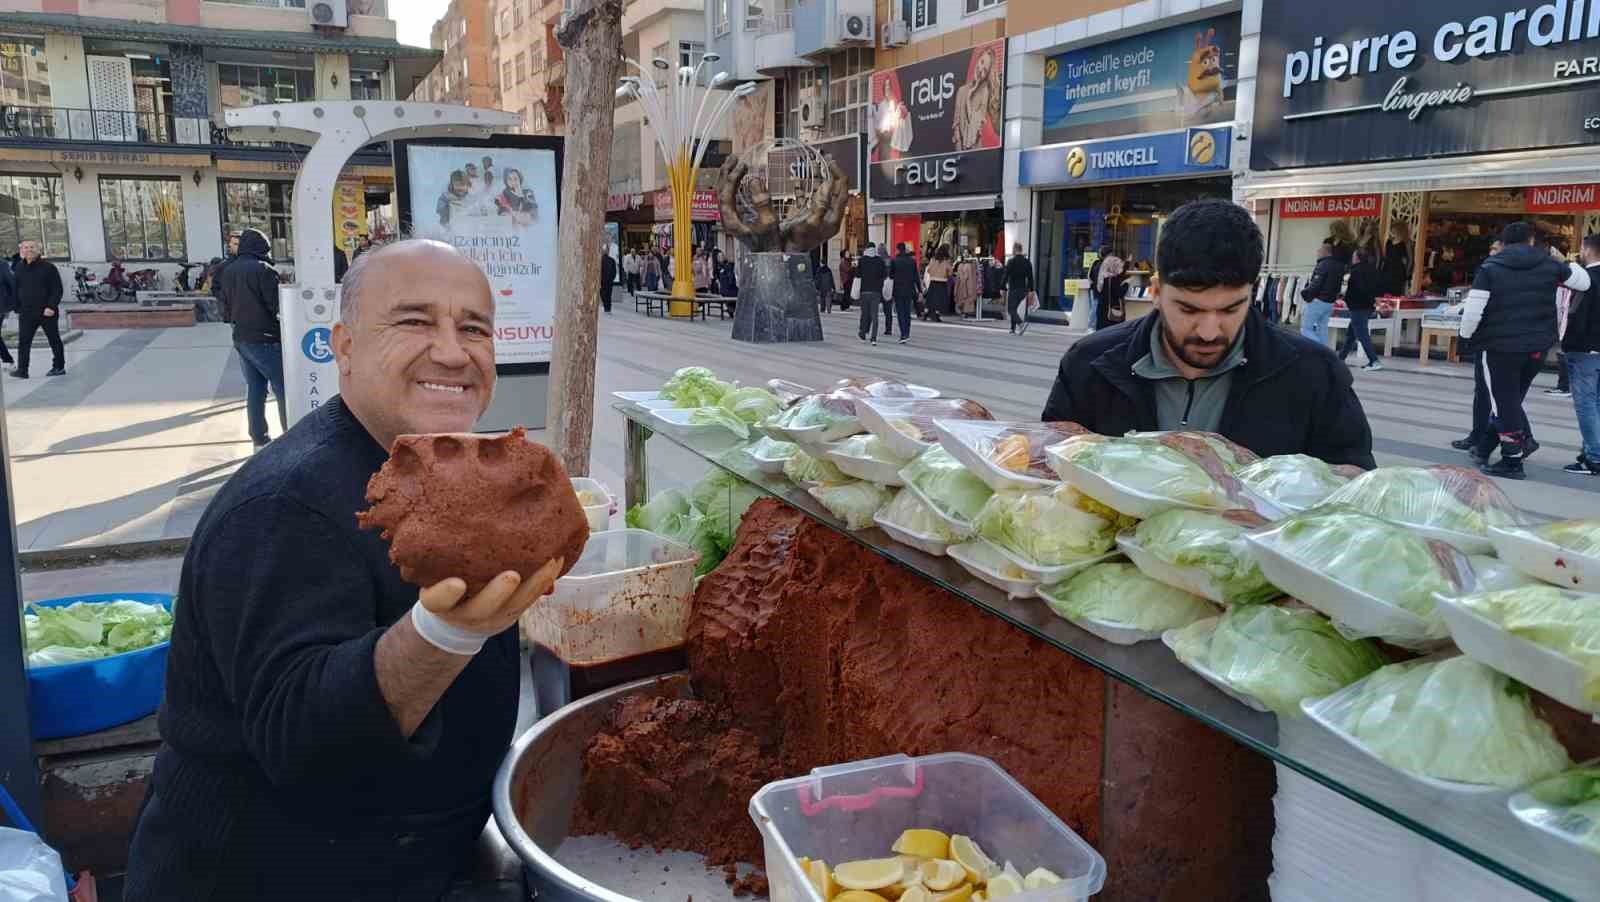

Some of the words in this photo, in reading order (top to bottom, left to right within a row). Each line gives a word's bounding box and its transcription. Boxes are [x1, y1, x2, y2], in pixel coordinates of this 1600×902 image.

[1067, 54, 1119, 79] Turkcell'le
[1123, 46, 1155, 66] evde
[1283, 29, 1417, 97] pierre
[911, 72, 955, 109] rays
[1065, 80, 1111, 100] internet
[1114, 68, 1151, 92] keyfi!
[1381, 77, 1473, 120] lingerie
[894, 158, 957, 189] rays
[1090, 147, 1158, 169] TURKCELL
[1328, 197, 1376, 212] BAŞLADI
[1533, 184, 1595, 205] İNDİRİMİ
